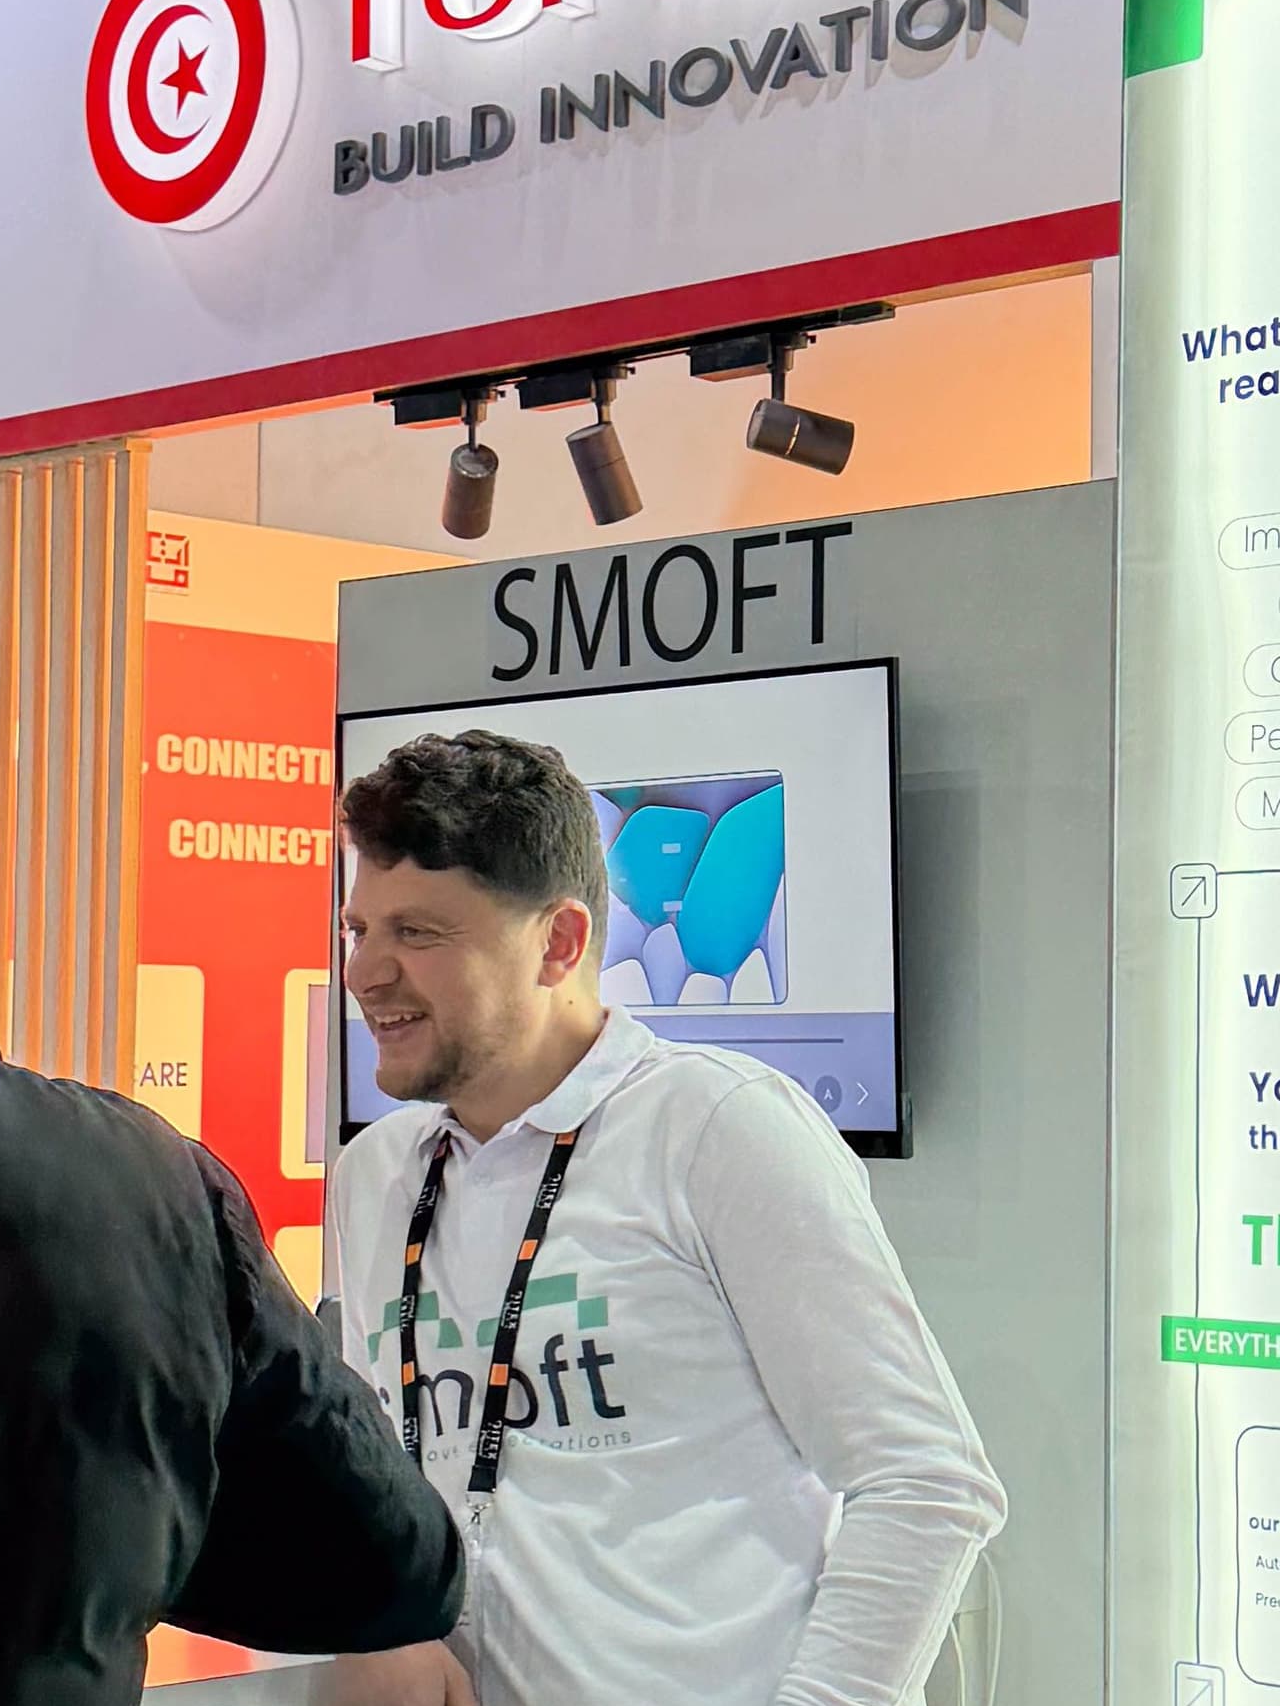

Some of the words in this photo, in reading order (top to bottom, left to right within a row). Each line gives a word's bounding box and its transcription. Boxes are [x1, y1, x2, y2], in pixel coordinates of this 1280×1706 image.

[334, 104, 514, 196] BUILD
[491, 522, 853, 682] SMOFT
[1248, 1516, 1280, 1533] our
